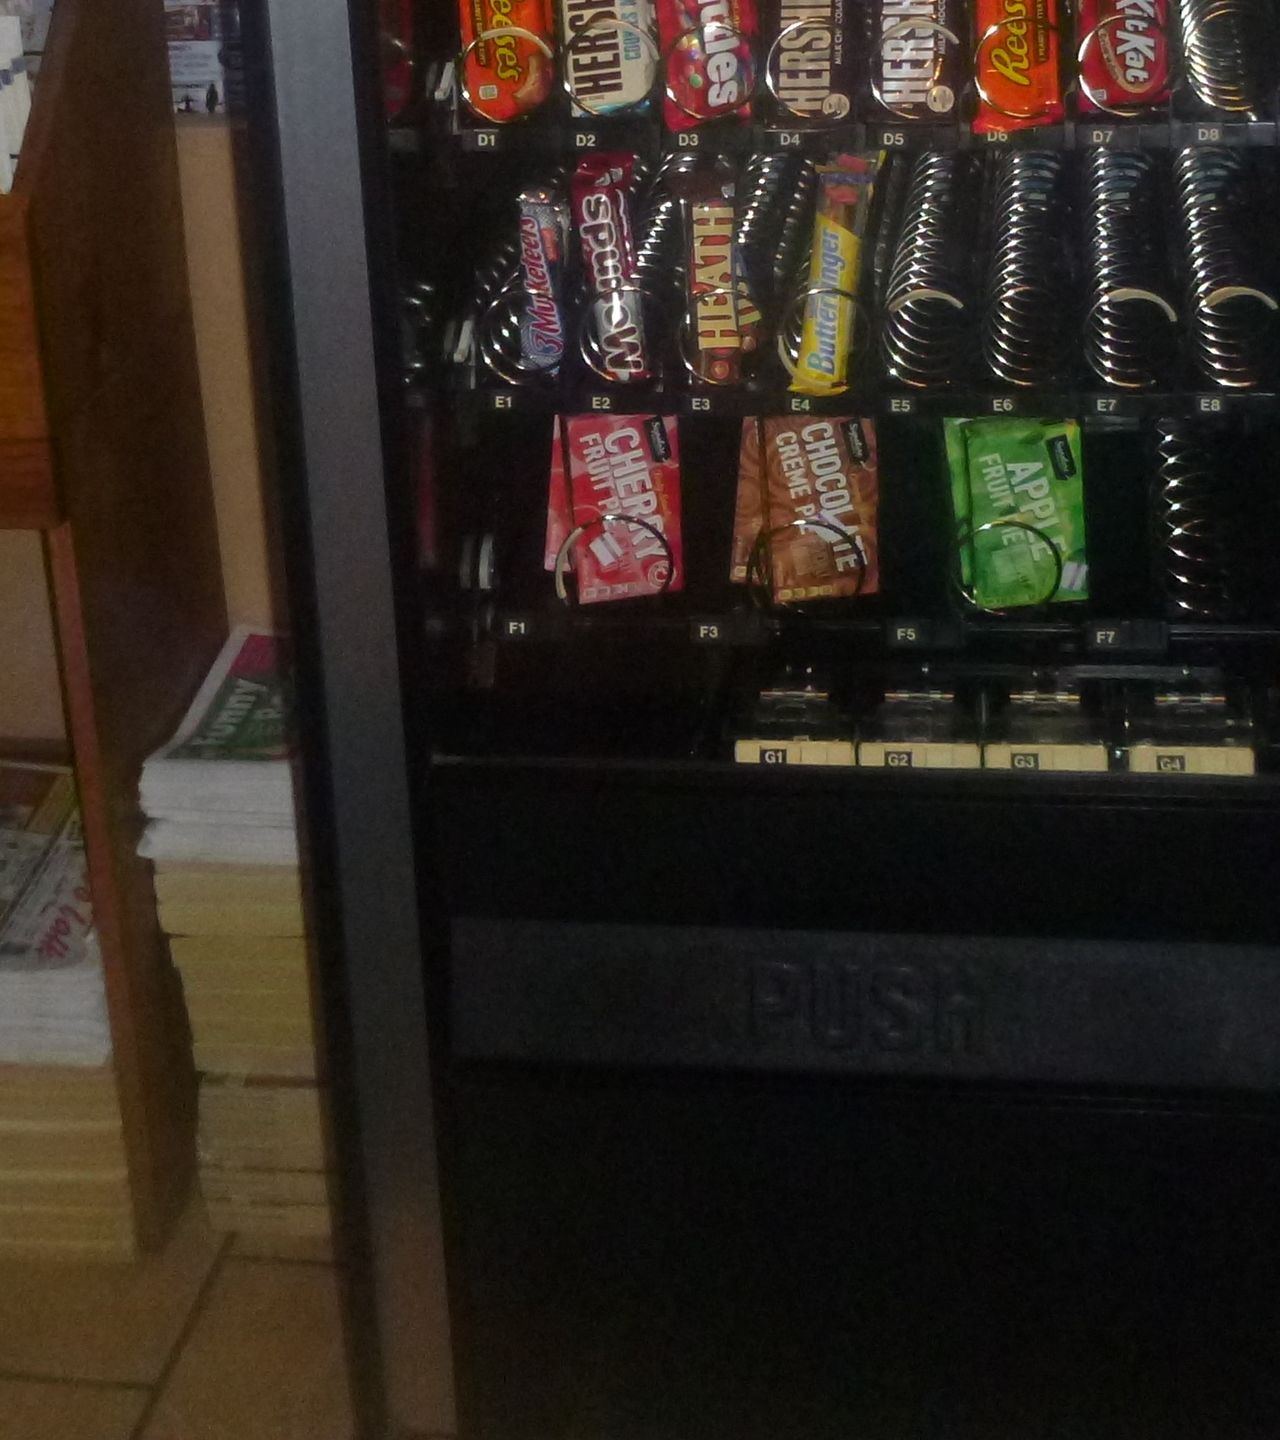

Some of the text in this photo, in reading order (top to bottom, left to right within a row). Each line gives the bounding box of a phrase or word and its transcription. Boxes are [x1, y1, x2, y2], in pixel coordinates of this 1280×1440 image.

[478, 133, 496, 147] D1
[576, 133, 596, 147] D2
[678, 133, 698, 147] D3
[780, 132, 800, 146] D4
[883, 133, 904, 146] D5
[987, 130, 1008, 143] D6
[1092, 130, 1113, 143] D7
[1198, 128, 1219, 141] D8
[522, 216, 563, 336] Muketeers
[582, 192, 644, 373] Mounds
[694, 206, 740, 350] HEATH
[495, 396, 512, 409] E1
[592, 397, 610, 410] E2
[692, 398, 710, 411] E3
[791, 398, 810, 411] E4
[891, 399, 910, 412] E5
[993, 399, 1013, 412] E6
[1097, 399, 1117, 412] E7
[1200, 398, 1220, 412] E8
[578, 432, 615, 492] FRUIT
[774, 431, 811, 500] CREME
[604, 427, 669, 561] CHERRY
[509, 622, 526, 634] F1
[700, 626, 718, 639] F3
[897, 628, 916, 641] F5
[1096, 631, 1116, 644] F7
[764, 749, 784, 764] G1
[887, 752, 909, 767] G2
[1013, 754, 1035, 769] G3
[1158, 756, 1182, 771] G4
[750, 962, 983, 1052] PUSH
